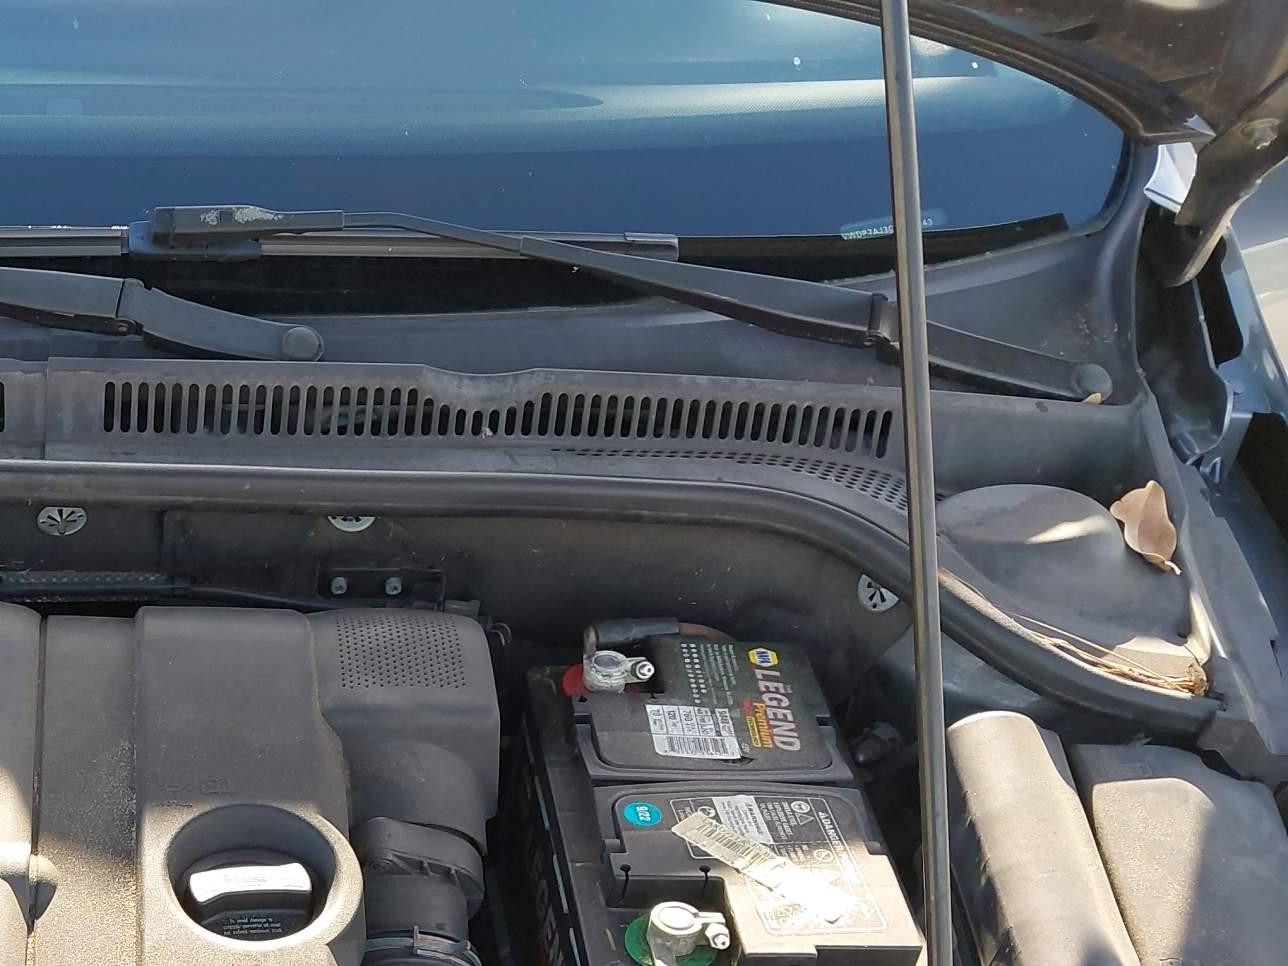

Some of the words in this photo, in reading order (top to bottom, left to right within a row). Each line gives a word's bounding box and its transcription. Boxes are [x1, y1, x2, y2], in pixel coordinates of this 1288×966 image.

[753, 702, 773, 748] Premium
[754, 669, 801, 751] LEGEND
[636, 805, 651, 821] 9/22
